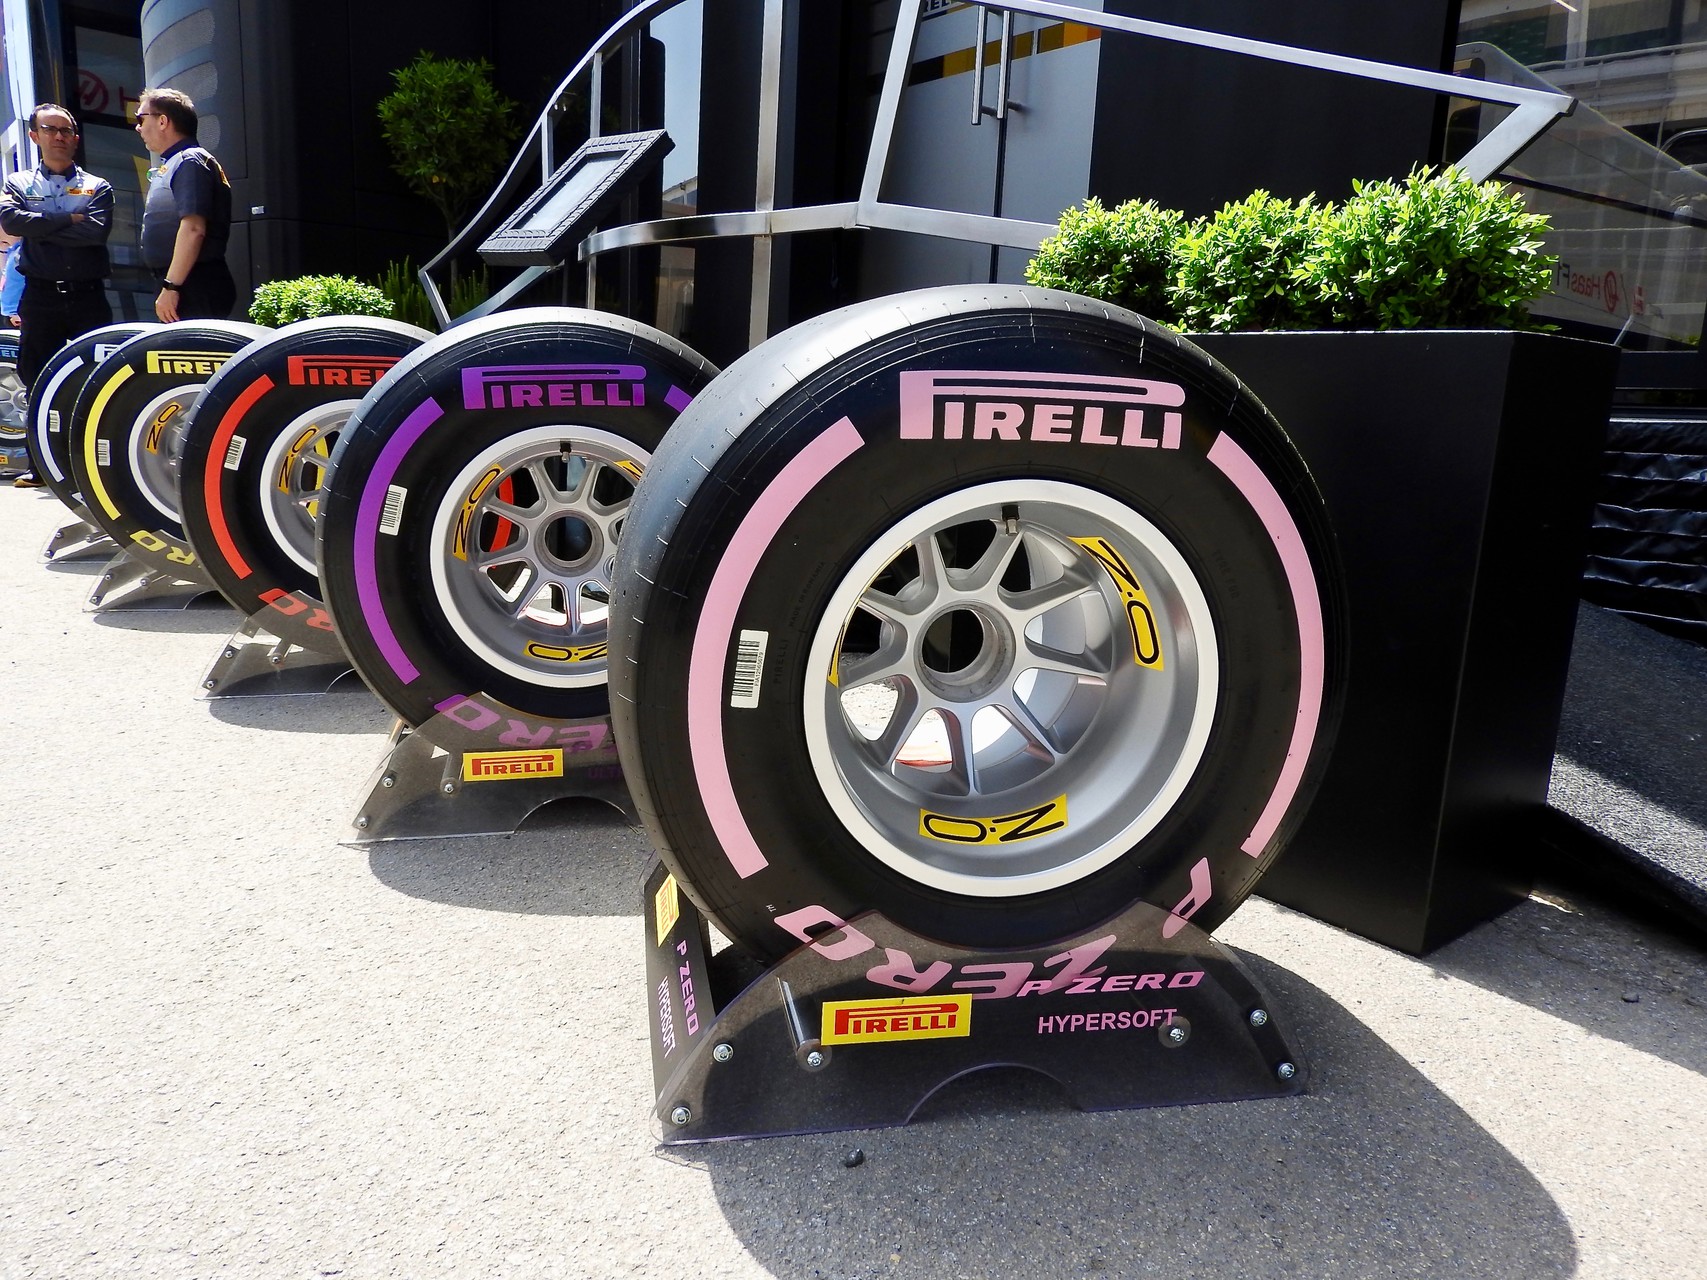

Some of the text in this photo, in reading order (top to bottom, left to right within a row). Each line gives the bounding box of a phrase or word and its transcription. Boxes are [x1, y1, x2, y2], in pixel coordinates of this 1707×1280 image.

[461, 364, 647, 410] PIRELLI
[900, 369, 1186, 450] PIRELLI
[471, 754, 555, 776] PIRELLI
[1162, 856, 1213, 938] P
[676, 939, 700, 1036] P ZERO
[1016, 971, 1206, 998] P ZERO
[657, 975, 677, 1059] HYPERSOFT
[834, 1002, 960, 1035] PIRELLI
[1037, 1008, 1178, 1035] HYPERSOFT
